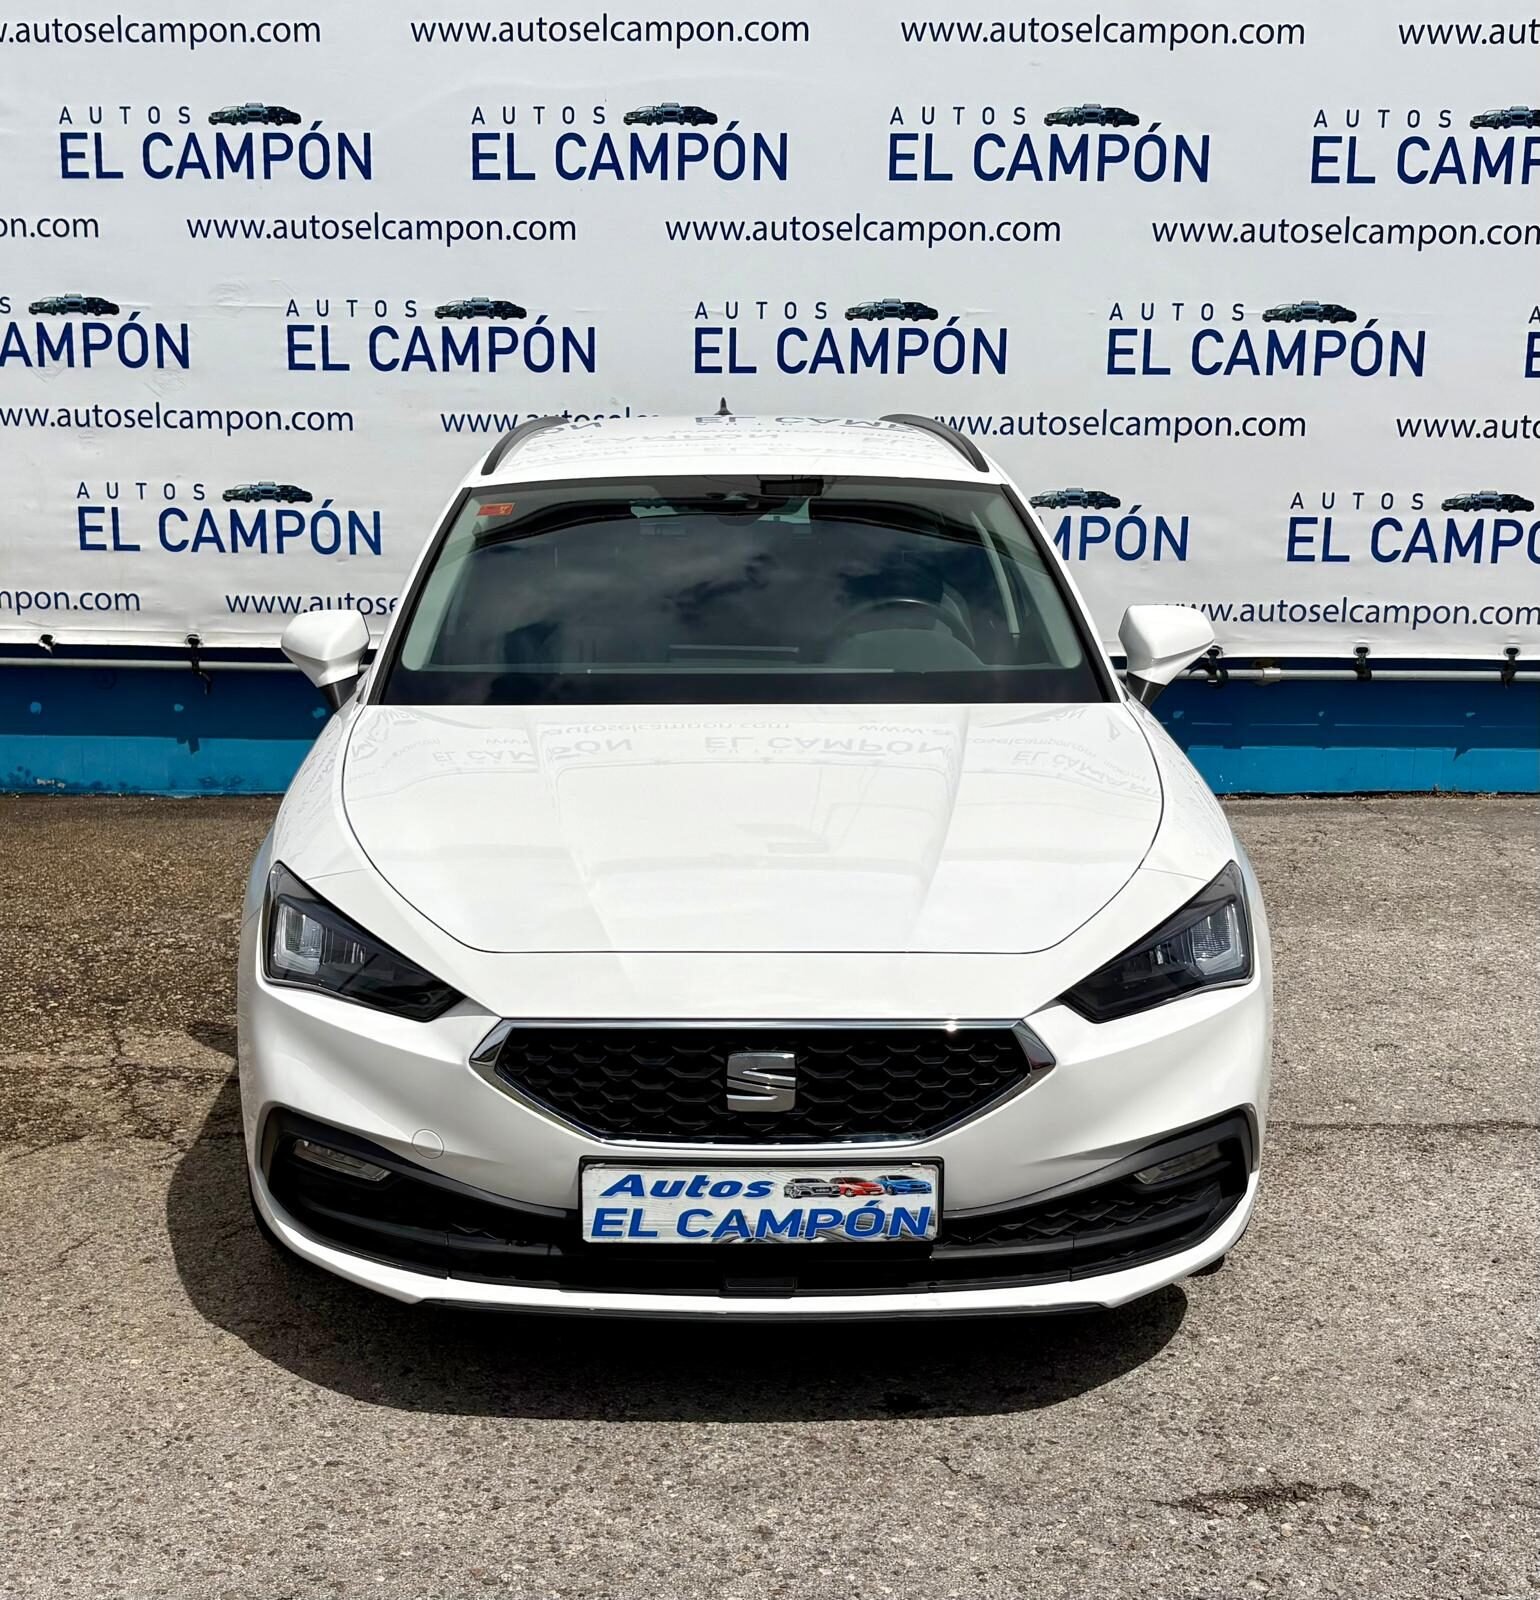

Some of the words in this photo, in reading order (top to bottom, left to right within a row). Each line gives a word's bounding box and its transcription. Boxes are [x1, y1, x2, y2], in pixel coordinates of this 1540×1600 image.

[0, 15, 320, 50] .autoselcampon.com
[411, 13, 809, 49] www.autoselcampon.com
[901, 14, 1304, 51] www.autoselcampon.com
[59, 106, 190, 124] AUTOS
[471, 106, 605, 125] AUTOS
[890, 106, 1025, 125] AUTOS
[1314, 109, 1451, 128] AUTOS
[60, 132, 124, 179] EL
[143, 121, 371, 180] CAMPÓN
[472, 133, 535, 180] EL
[556, 121, 787, 181] CAMPÓN
[889, 133, 953, 181] EL
[974, 122, 1209, 182] CAMPÓN
[1311, 136, 1376, 184] EL
[187, 212, 575, 247] www.autoselcampon.com
[665, 213, 1060, 248] www.autoselcampon.com
[286, 299, 417, 318] AUTOS
[695, 301, 827, 319] AUTOS
[1109, 303, 1244, 321] AUTOS
[0, 313, 189, 369] AMPÓN
[287, 325, 350, 371] EL
[369, 314, 595, 373] CAMPÓN
[695, 327, 757, 373] EL
[777, 316, 1007, 374] CAMPÓN
[1107, 328, 1171, 375] EL
[1192, 319, 1425, 377] CAMPÓN
[77, 482, 205, 501] AUTOS
[1290, 492, 1423, 510] AUTOS
[78, 506, 141, 552] EL
[159, 499, 381, 555] CAMPÓN
[1287, 517, 1350, 562] EL
[1176, 597, 1540, 630] w.autoselcampon.com
[600, 1174, 775, 1199] Autos
[591, 1207, 659, 1237] EL
[676, 1200, 931, 1238] CAMPÓN
